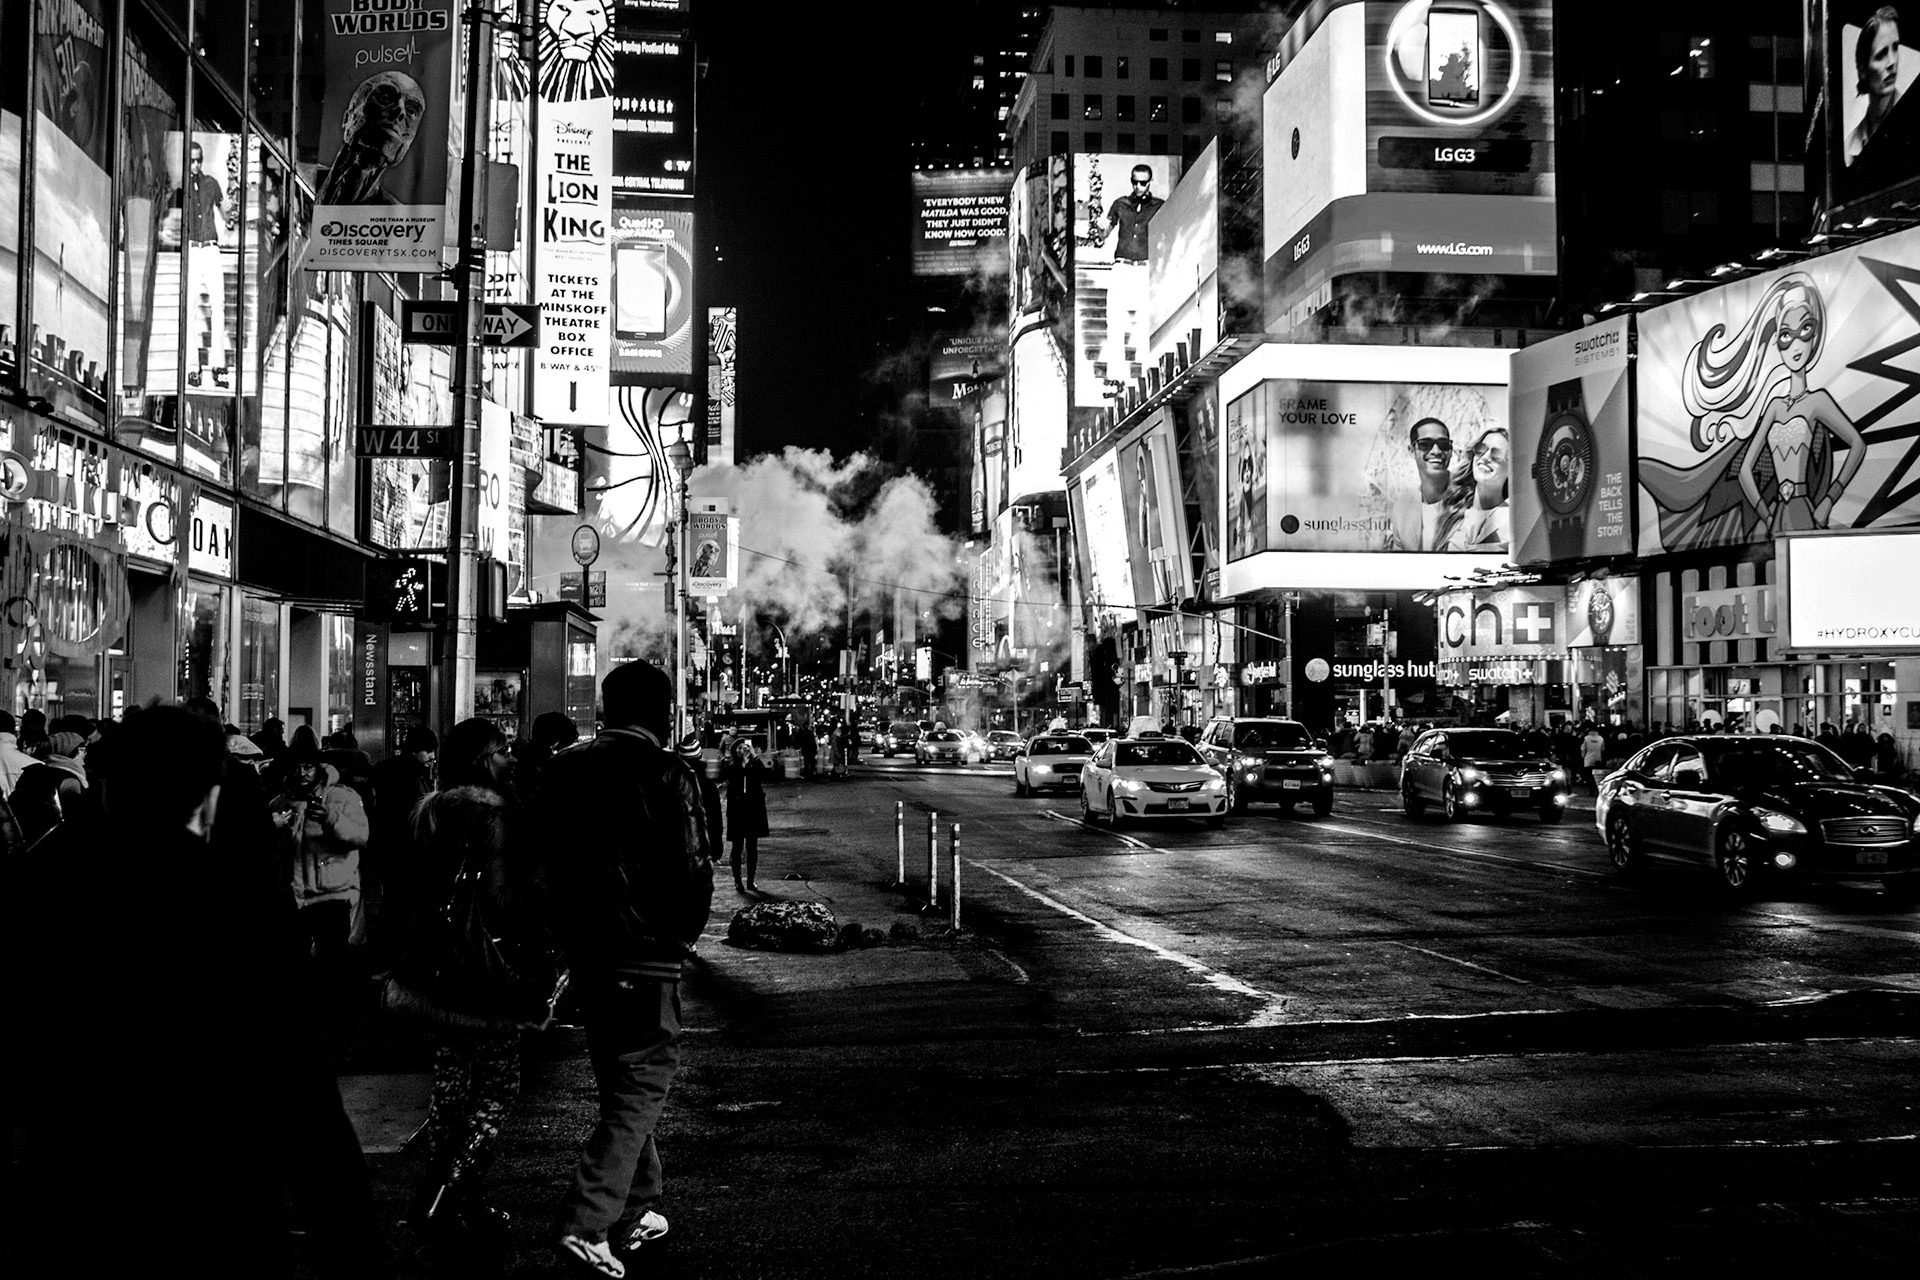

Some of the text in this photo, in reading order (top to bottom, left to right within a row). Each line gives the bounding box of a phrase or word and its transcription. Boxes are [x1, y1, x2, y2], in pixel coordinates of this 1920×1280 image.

[331, 11, 448, 34] WORLDS
[551, 119, 593, 139] Disney
[1434, 148, 1476, 162] LG G3
[555, 153, 590, 171] THE
[548, 174, 598, 203] LION
[978, 196, 1004, 205] KNEW
[921, 207, 1009, 218] MATILDA WAS GOOD,
[544, 208, 605, 242] KING
[619, 216, 664, 229] Quad HD
[926, 218, 1002, 228] THEY JUST DIDN'T
[326, 221, 425, 243] Discovery
[925, 230, 952, 239] KNOW
[954, 229, 976, 238] HOW
[320, 248, 436, 258] DISCOVERYTSX.COM
[1294, 234, 1310, 261] LG G3
[1417, 243, 1493, 256] www.LG.com
[548, 274, 598, 286] TICKETS
[551, 289, 594, 300] AT THE
[540, 302, 607, 315] MINSKOFF
[484, 318, 519, 334] WAY
[545, 317, 599, 329] THEATRE
[558, 332, 585, 342] BOX
[983, 336, 1000, 344] AND
[1575, 331, 1613, 354] swatch
[551, 347, 593, 357] OFFICE
[619, 349, 662, 358] SAMSUNG
[1575, 349, 1620, 366] SISTEM51
[1279, 399, 1327, 411] FRAME
[1279, 413, 1357, 425] YOUR LOVE
[362, 430, 439, 454] W 44 St
[1606, 473, 1622, 484] THE
[1601, 486, 1622, 498] BACK
[1599, 499, 1623, 511] TELLS
[1607, 512, 1623, 523] THE
[1304, 516, 1392, 533] sunglass hut
[1598, 525, 1623, 538] STORY
[365, 634, 377, 706] Newsstand
[1333, 660, 1404, 681] sunglass
[1407, 660, 1436, 676] hut
[1469, 666, 1522, 680] swatch
